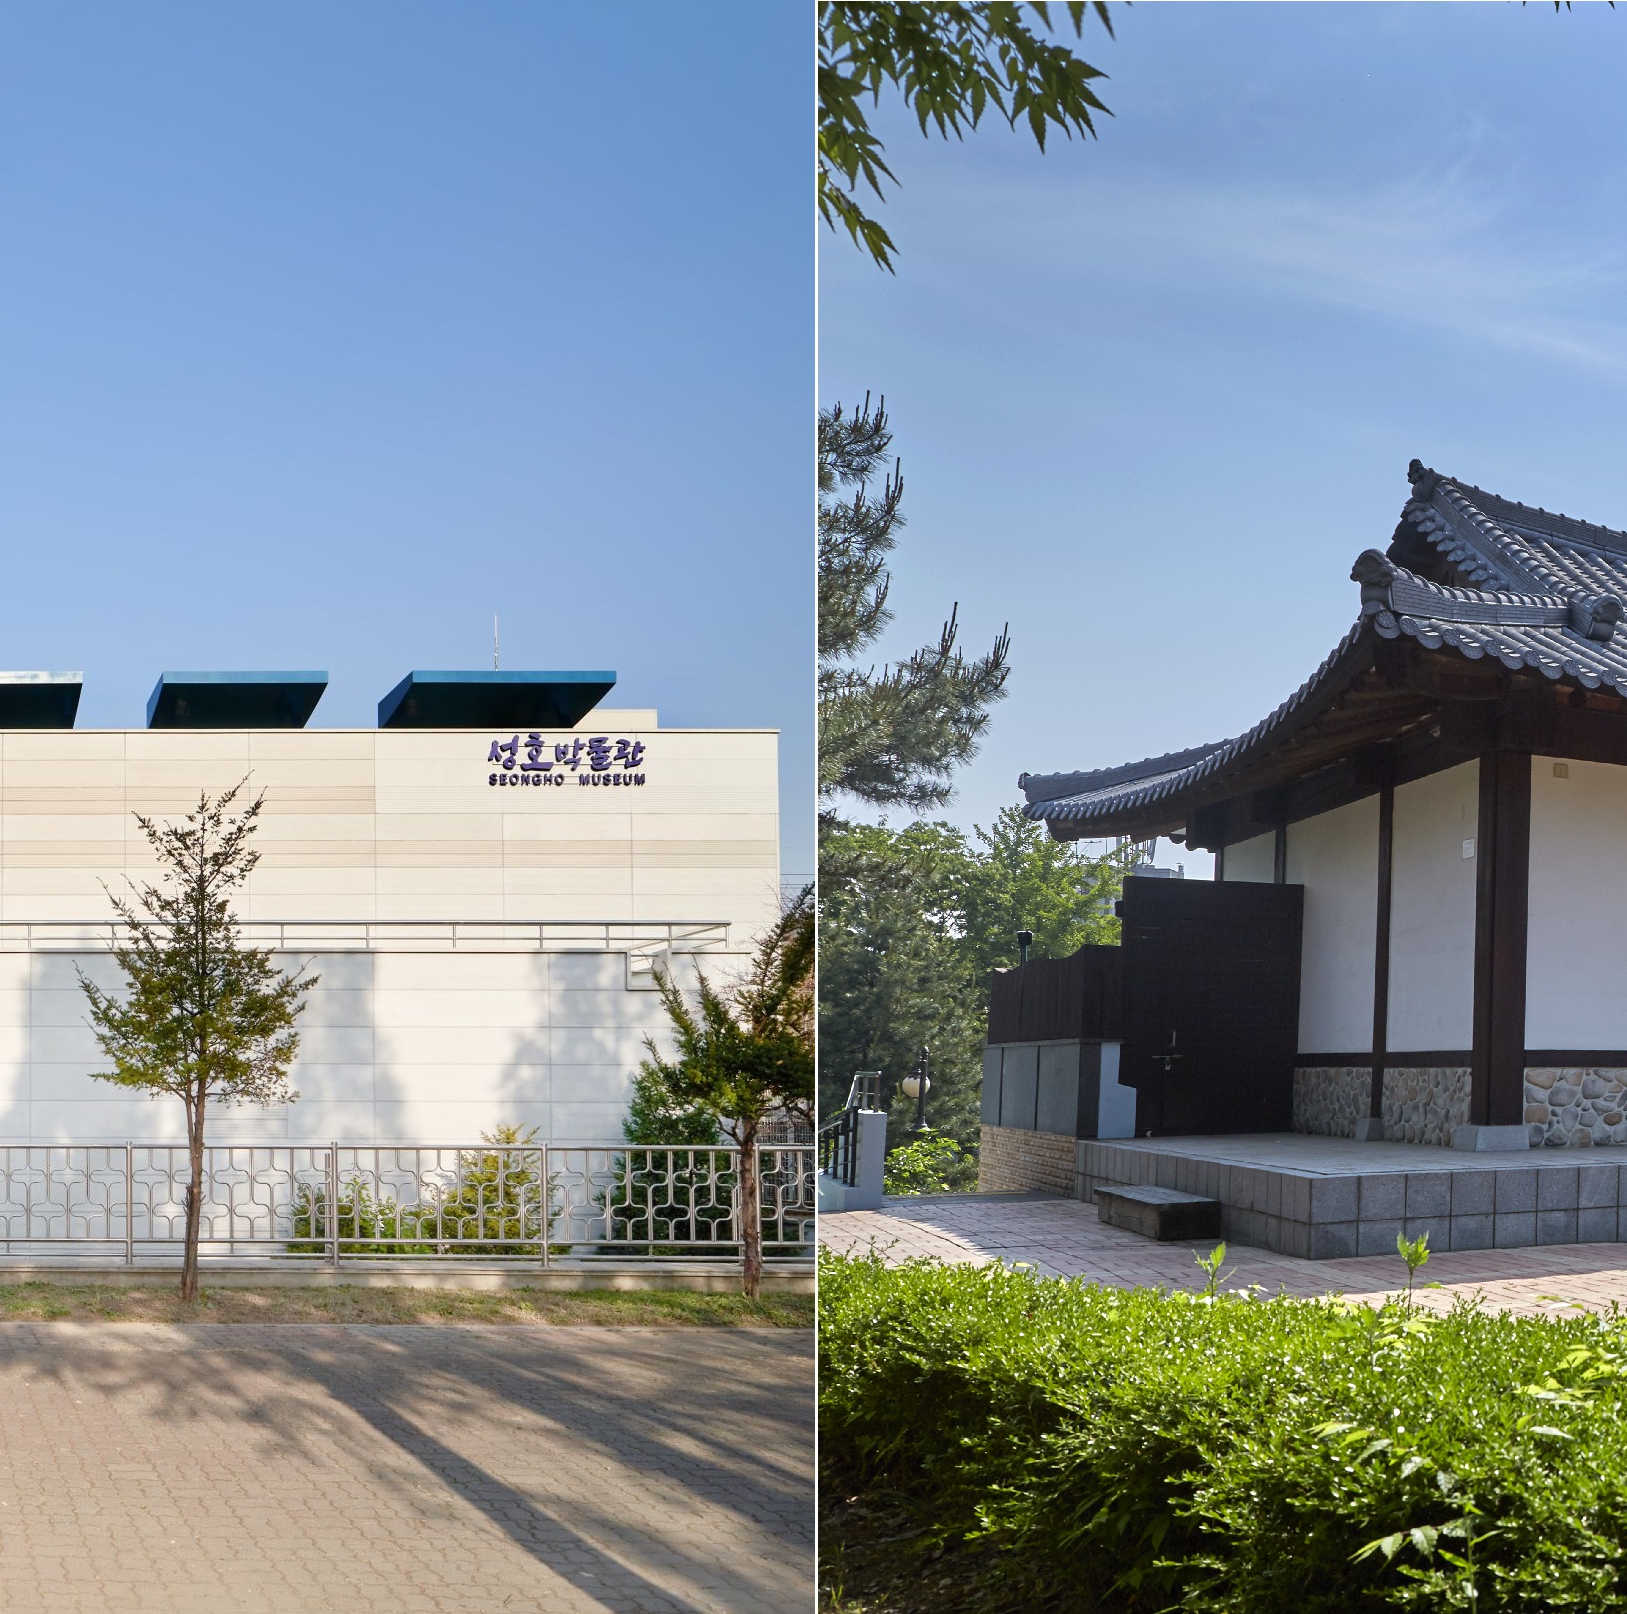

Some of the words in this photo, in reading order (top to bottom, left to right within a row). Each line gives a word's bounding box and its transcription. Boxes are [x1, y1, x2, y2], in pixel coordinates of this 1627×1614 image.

[488, 733, 646, 772] 성호박물관
[488, 773, 565, 787] SEONGHO
[579, 773, 646, 787] MUSEUM
